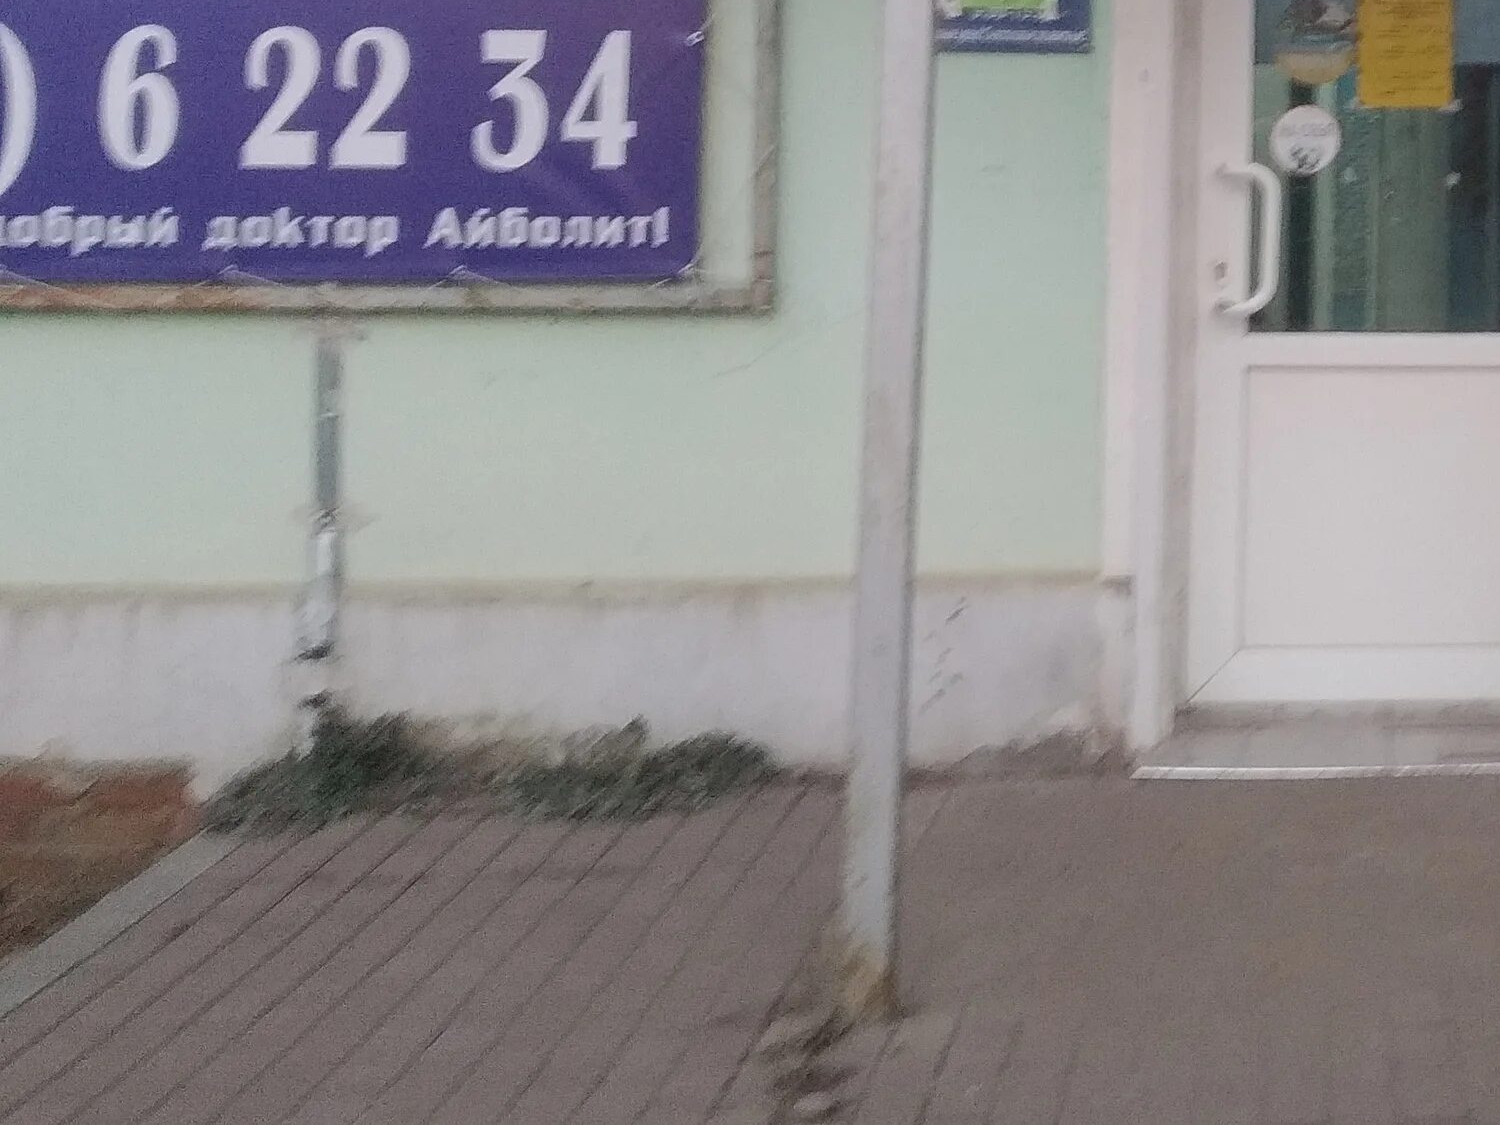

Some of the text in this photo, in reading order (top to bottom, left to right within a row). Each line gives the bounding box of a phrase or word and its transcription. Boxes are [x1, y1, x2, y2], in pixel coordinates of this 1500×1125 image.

[101, 24, 179, 170] 6
[238, 25, 410, 170] 22
[472, 29, 638, 171] 34
[0, 206, 671, 256] обрый доктор Айболит!
